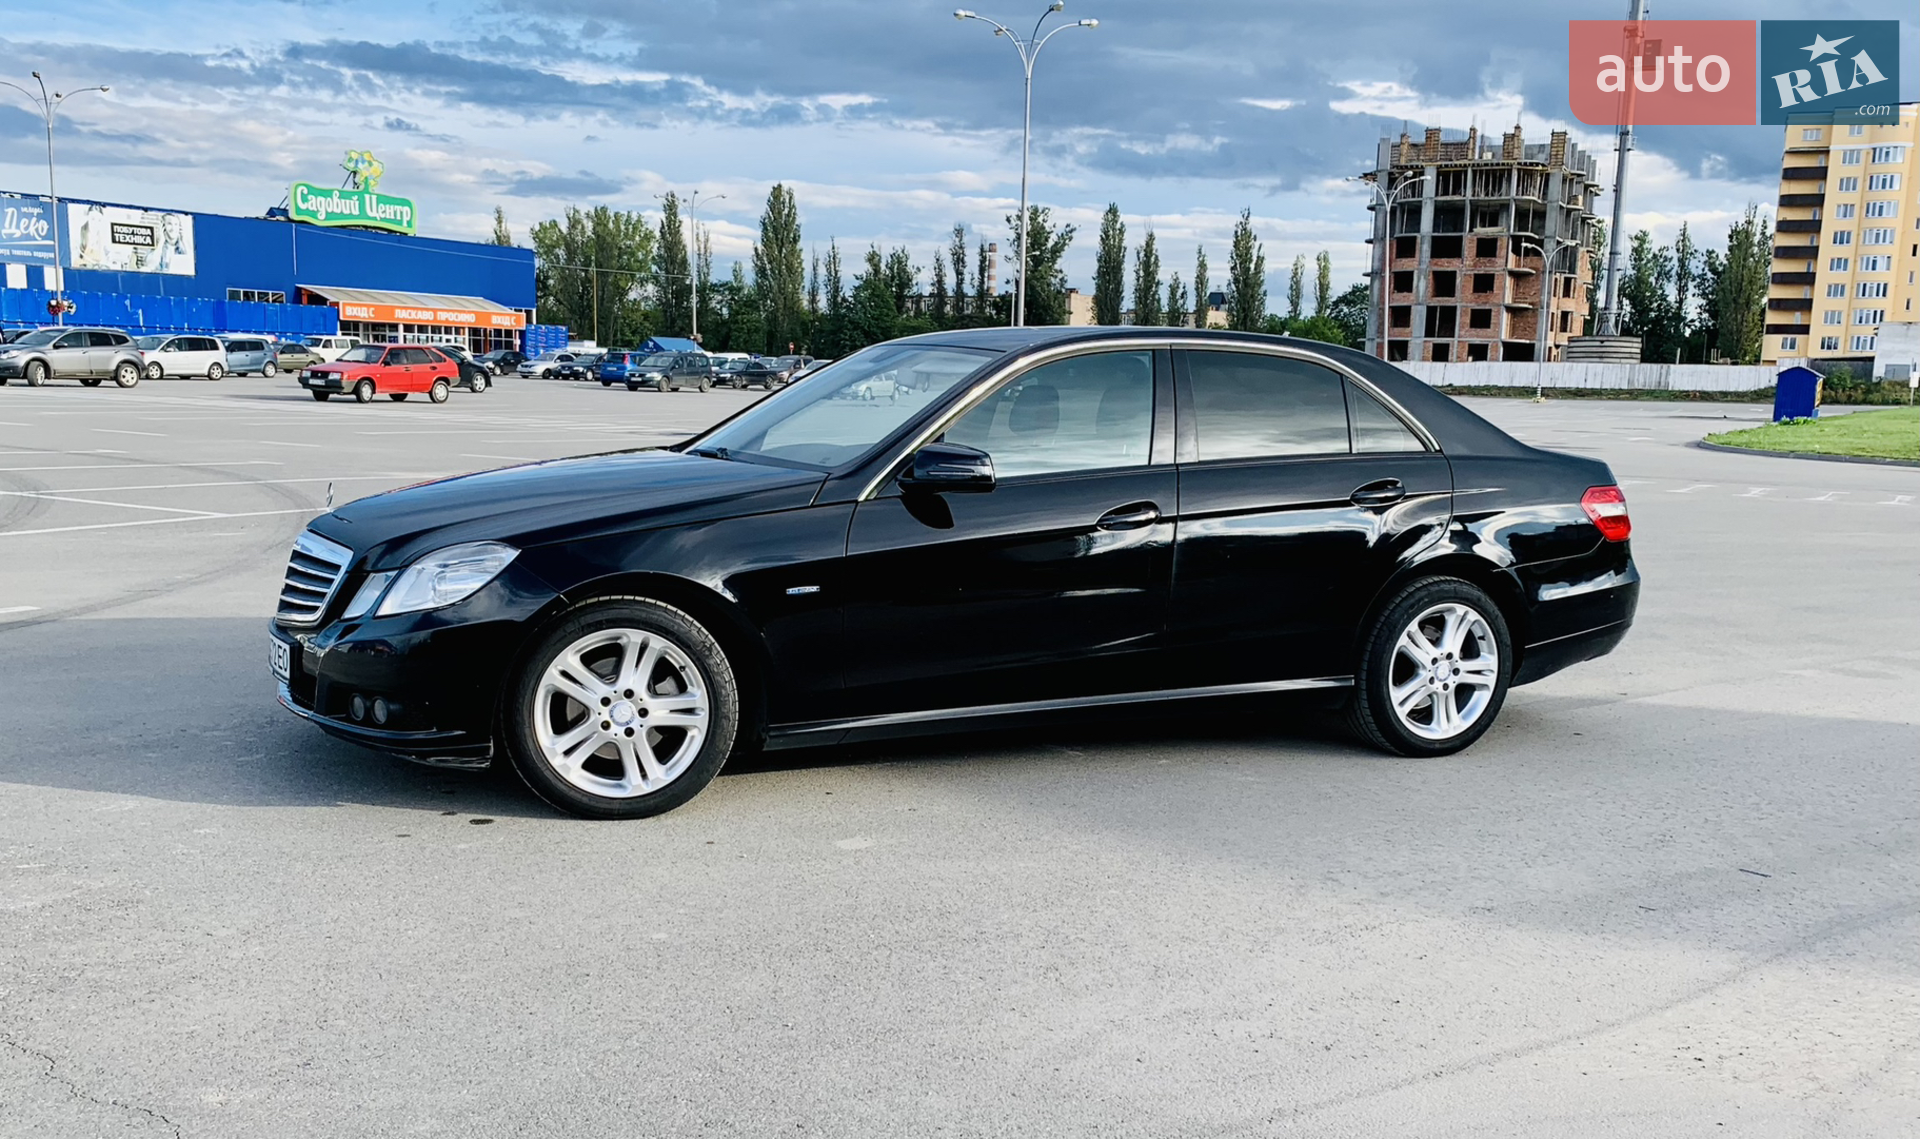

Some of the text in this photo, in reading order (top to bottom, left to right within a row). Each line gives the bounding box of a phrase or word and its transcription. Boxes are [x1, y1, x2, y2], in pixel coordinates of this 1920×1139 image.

[296, 185, 412, 228] Садовий Центр
[1, 206, 49, 241] Деко
[113, 225, 152, 236] ПОБУТОВА
[114, 233, 153, 245] ТЕХНІКА
[345, 305, 368, 319] ВХІД
[394, 308, 434, 321] ЛАСКАВО
[437, 312, 476, 323] ПРОСИМО
[491, 314, 510, 326] ВХІД
